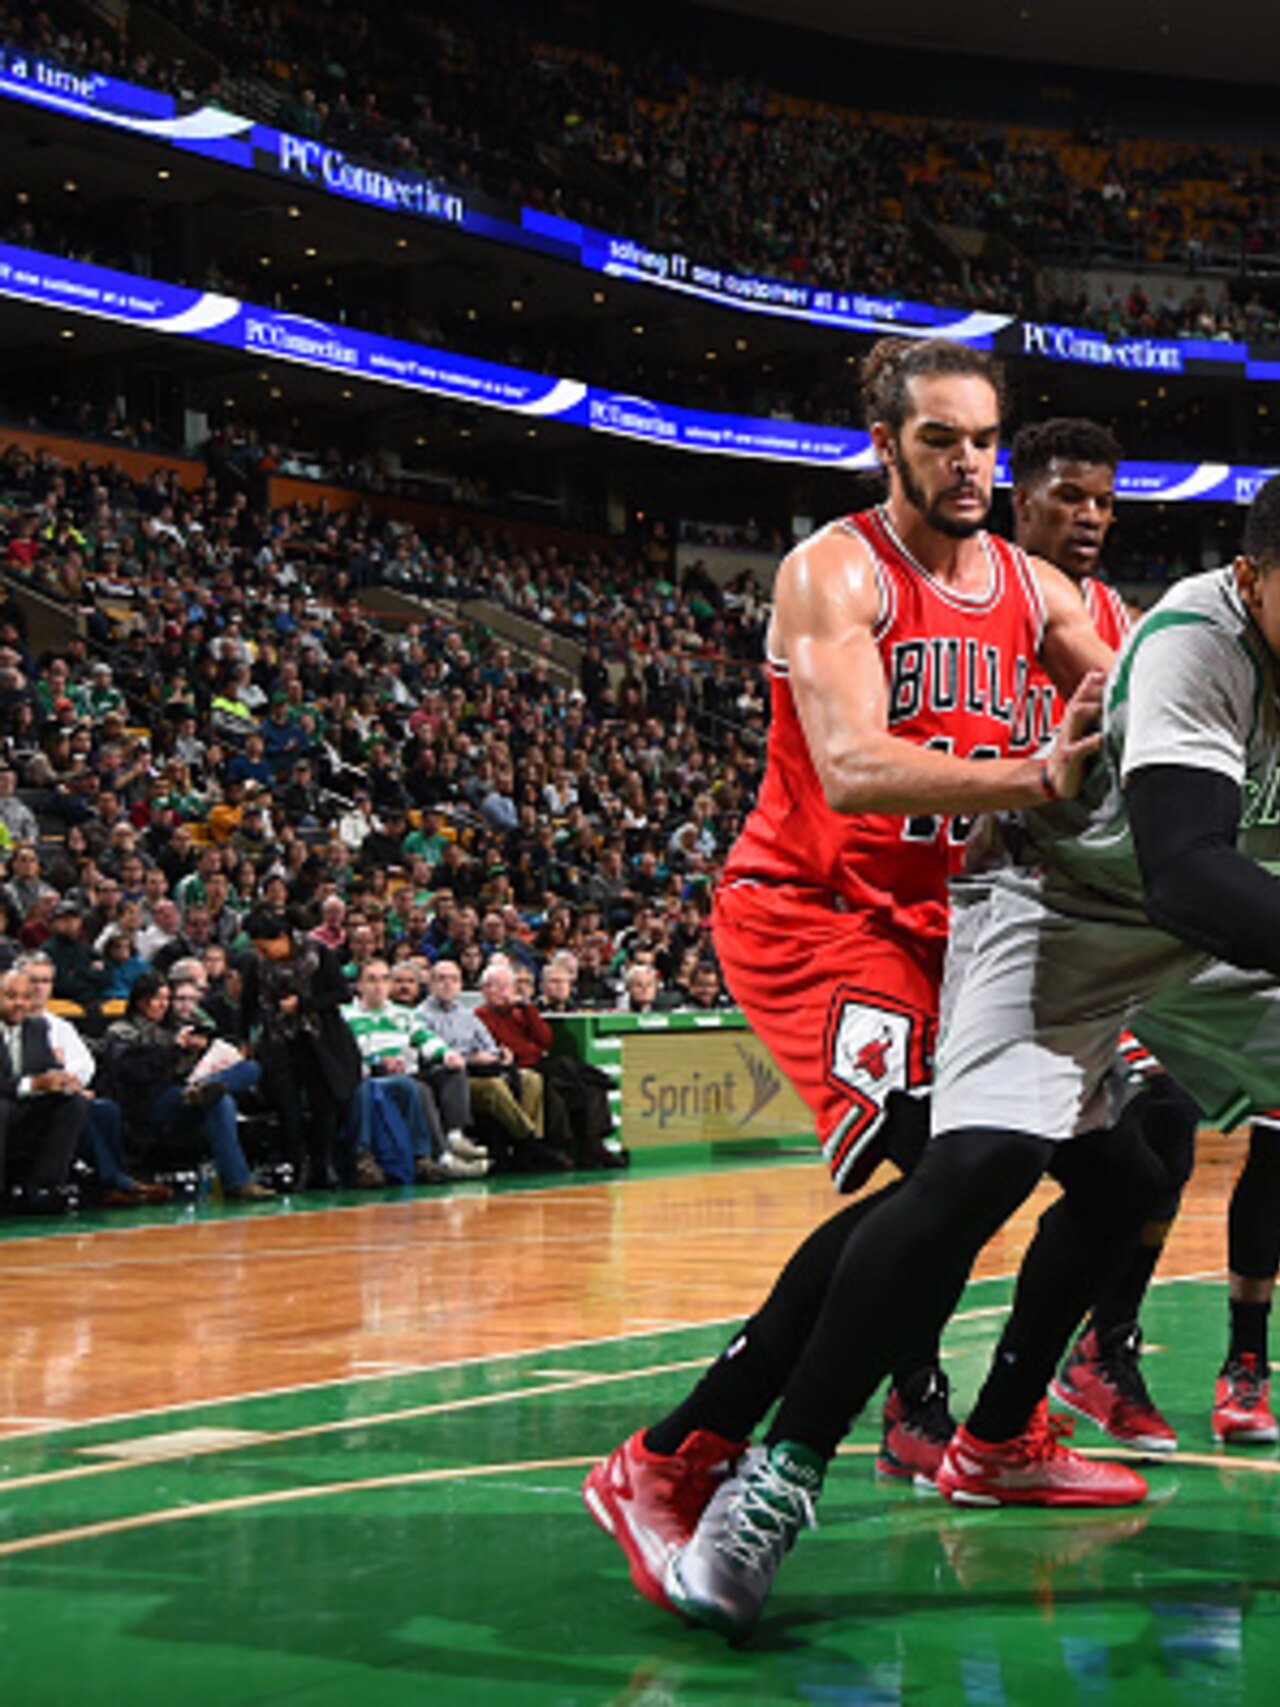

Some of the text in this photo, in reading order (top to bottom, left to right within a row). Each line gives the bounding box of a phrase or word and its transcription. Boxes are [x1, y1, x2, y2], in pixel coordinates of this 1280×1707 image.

[11, 58, 28, 80] a
[279, 133, 464, 222] PC Connection
[245, 318, 269, 342] PC
[270, 325, 359, 366] Connection
[1023, 322, 1181, 368] PC Connection
[640, 1072, 737, 1130] Sprint
